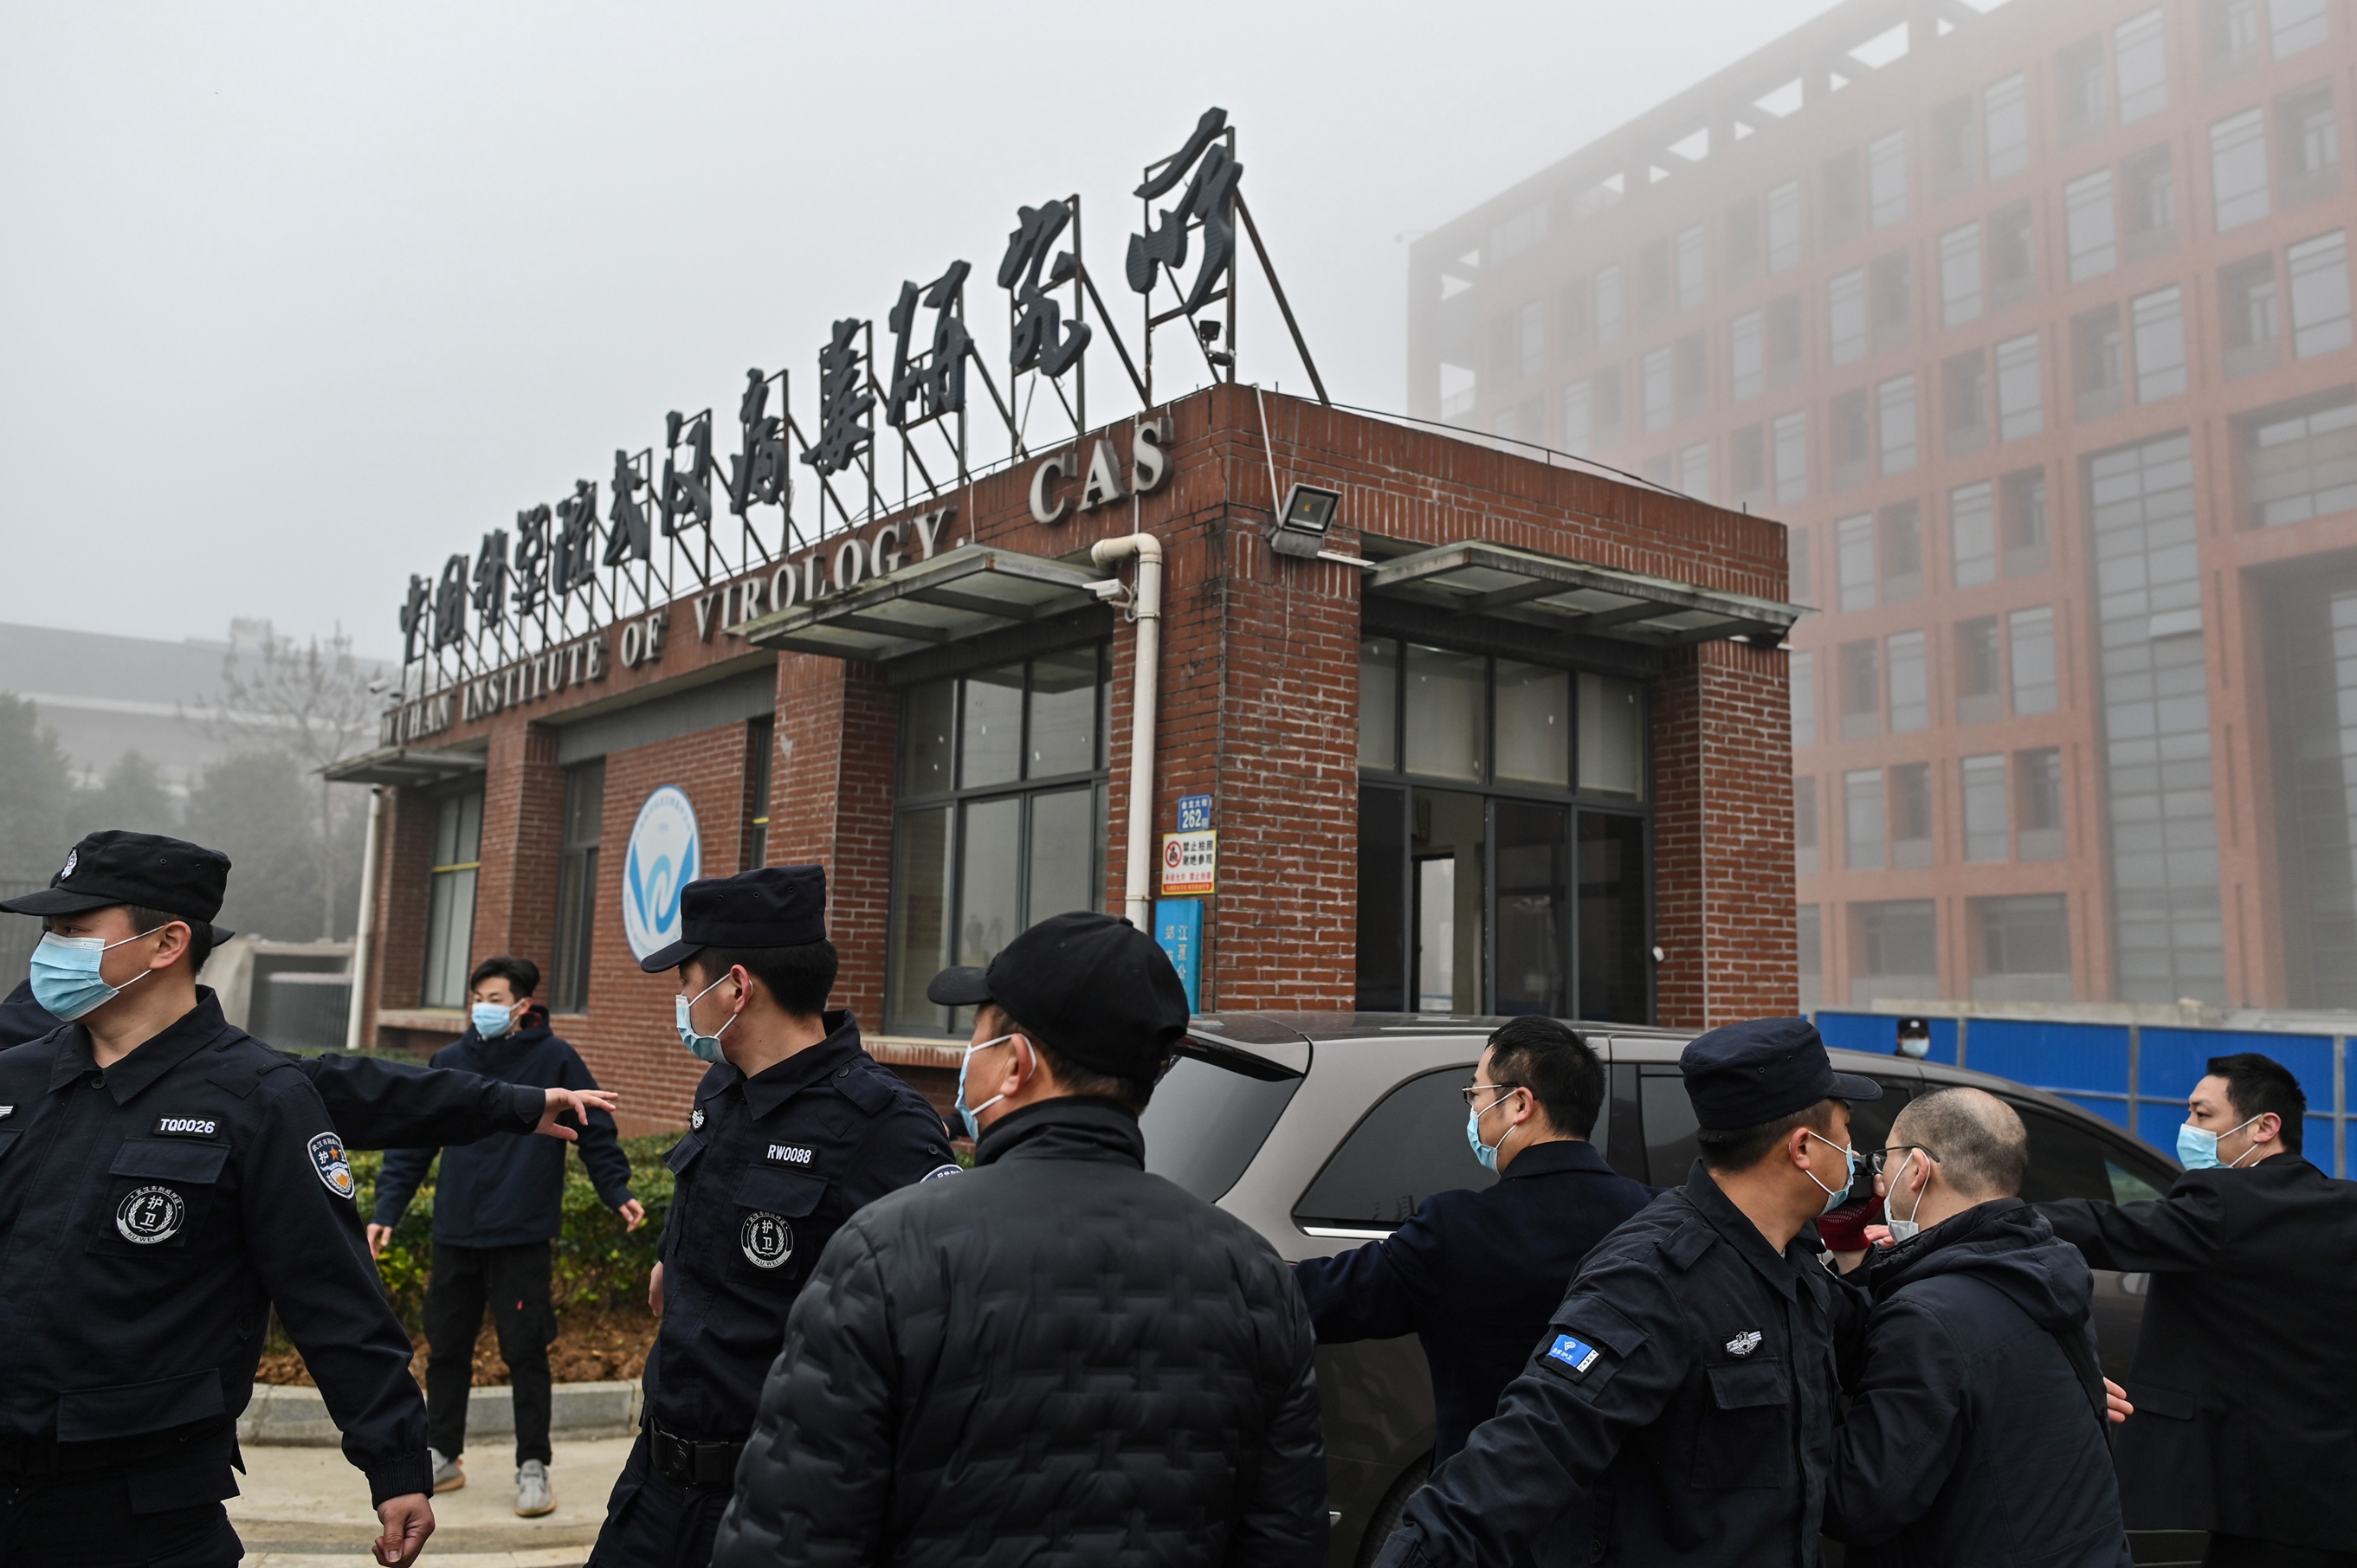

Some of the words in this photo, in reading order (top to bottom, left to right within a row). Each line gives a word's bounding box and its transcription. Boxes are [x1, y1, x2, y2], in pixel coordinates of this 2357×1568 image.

[462, 636, 604, 721] INSTITUTE
[620, 611, 663, 668] OF
[1030, 420, 1171, 525] CAS
[1178, 925, 1188, 992] 江夏公
[160, 1118, 216, 1133] TQ0026
[767, 1144, 812, 1164] RW0088
